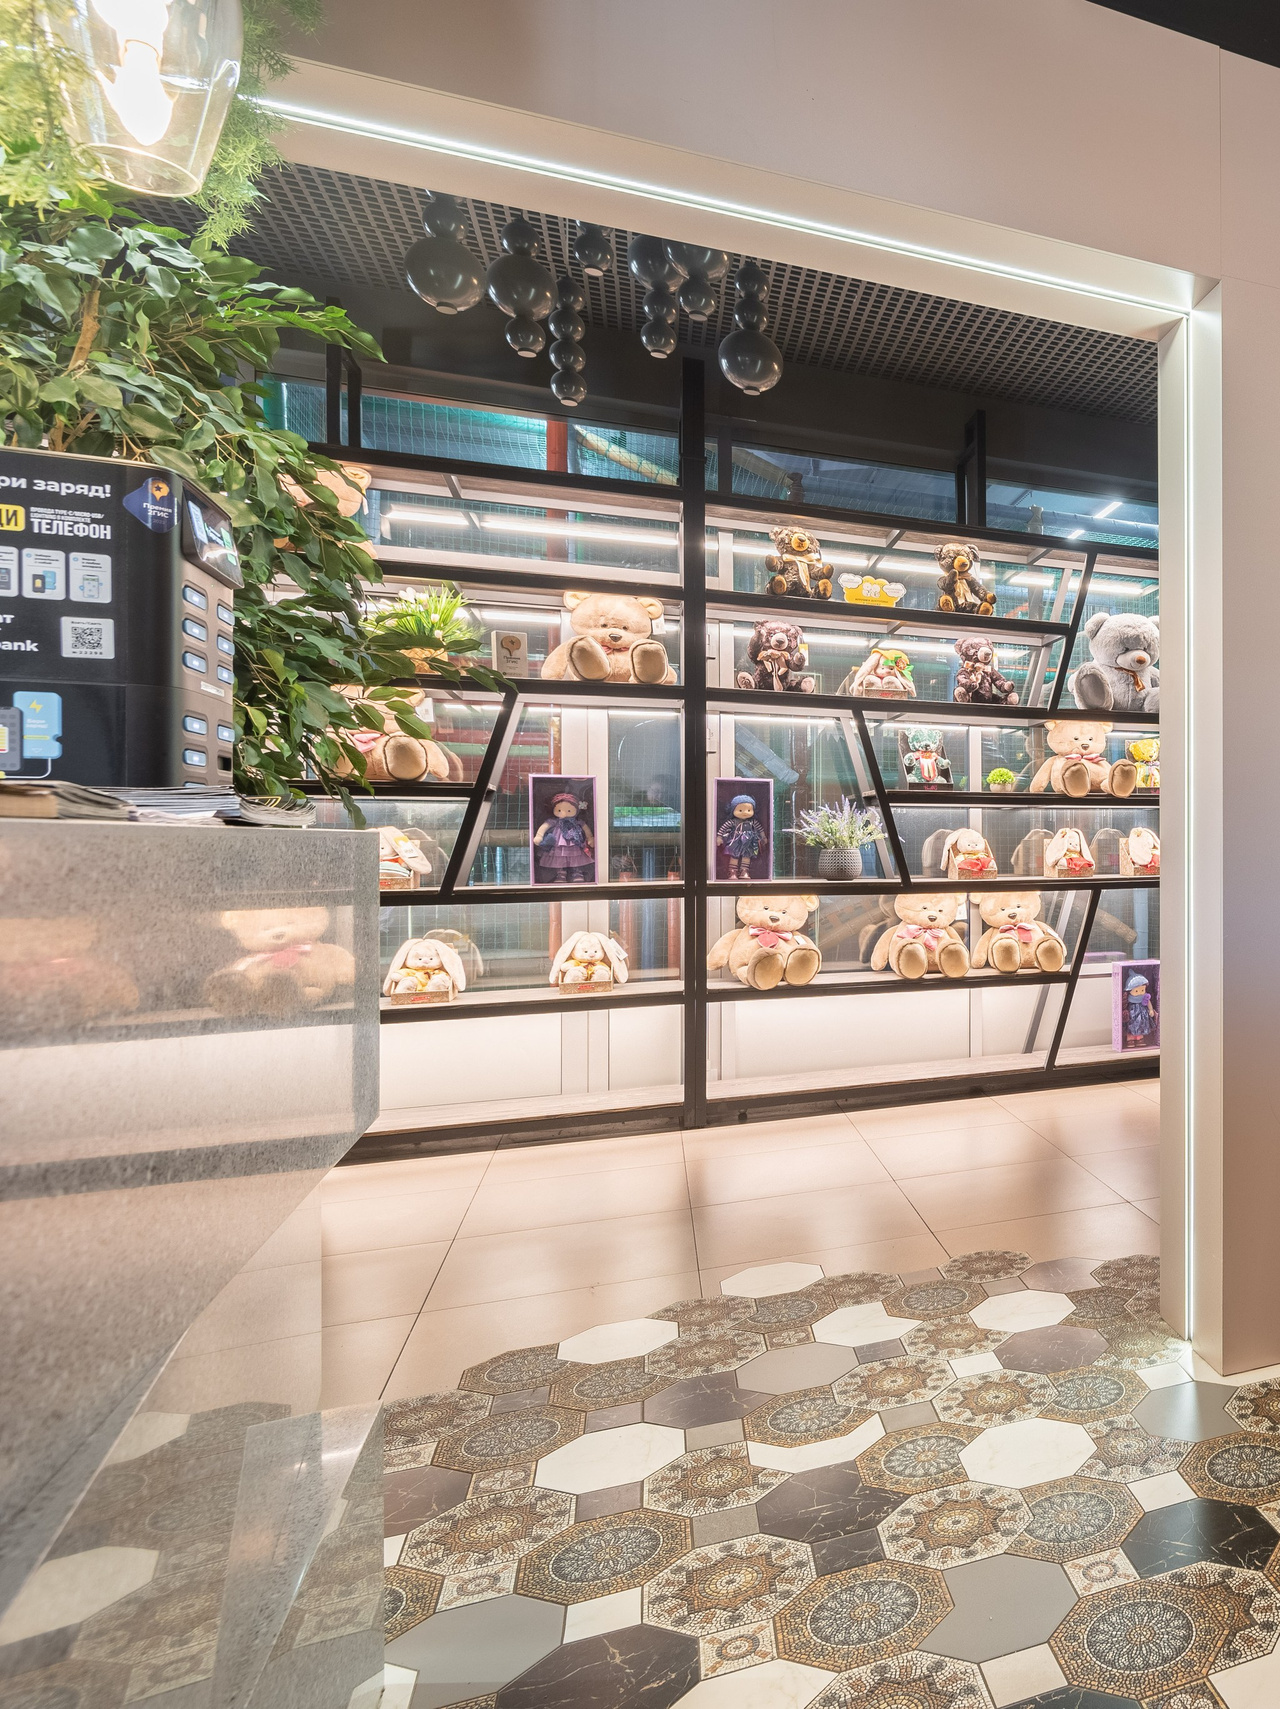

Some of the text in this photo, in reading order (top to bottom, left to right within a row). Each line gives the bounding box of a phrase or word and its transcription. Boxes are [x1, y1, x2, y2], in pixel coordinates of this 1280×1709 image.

[33, 480, 112, 498] заряд!
[143, 502, 173, 513] Премия
[147, 509, 169, 519] 2ГИС
[0, 509, 18, 527] И
[30, 518, 112, 540] ТЕЛЕФОН
[0, 640, 39, 652] ank
